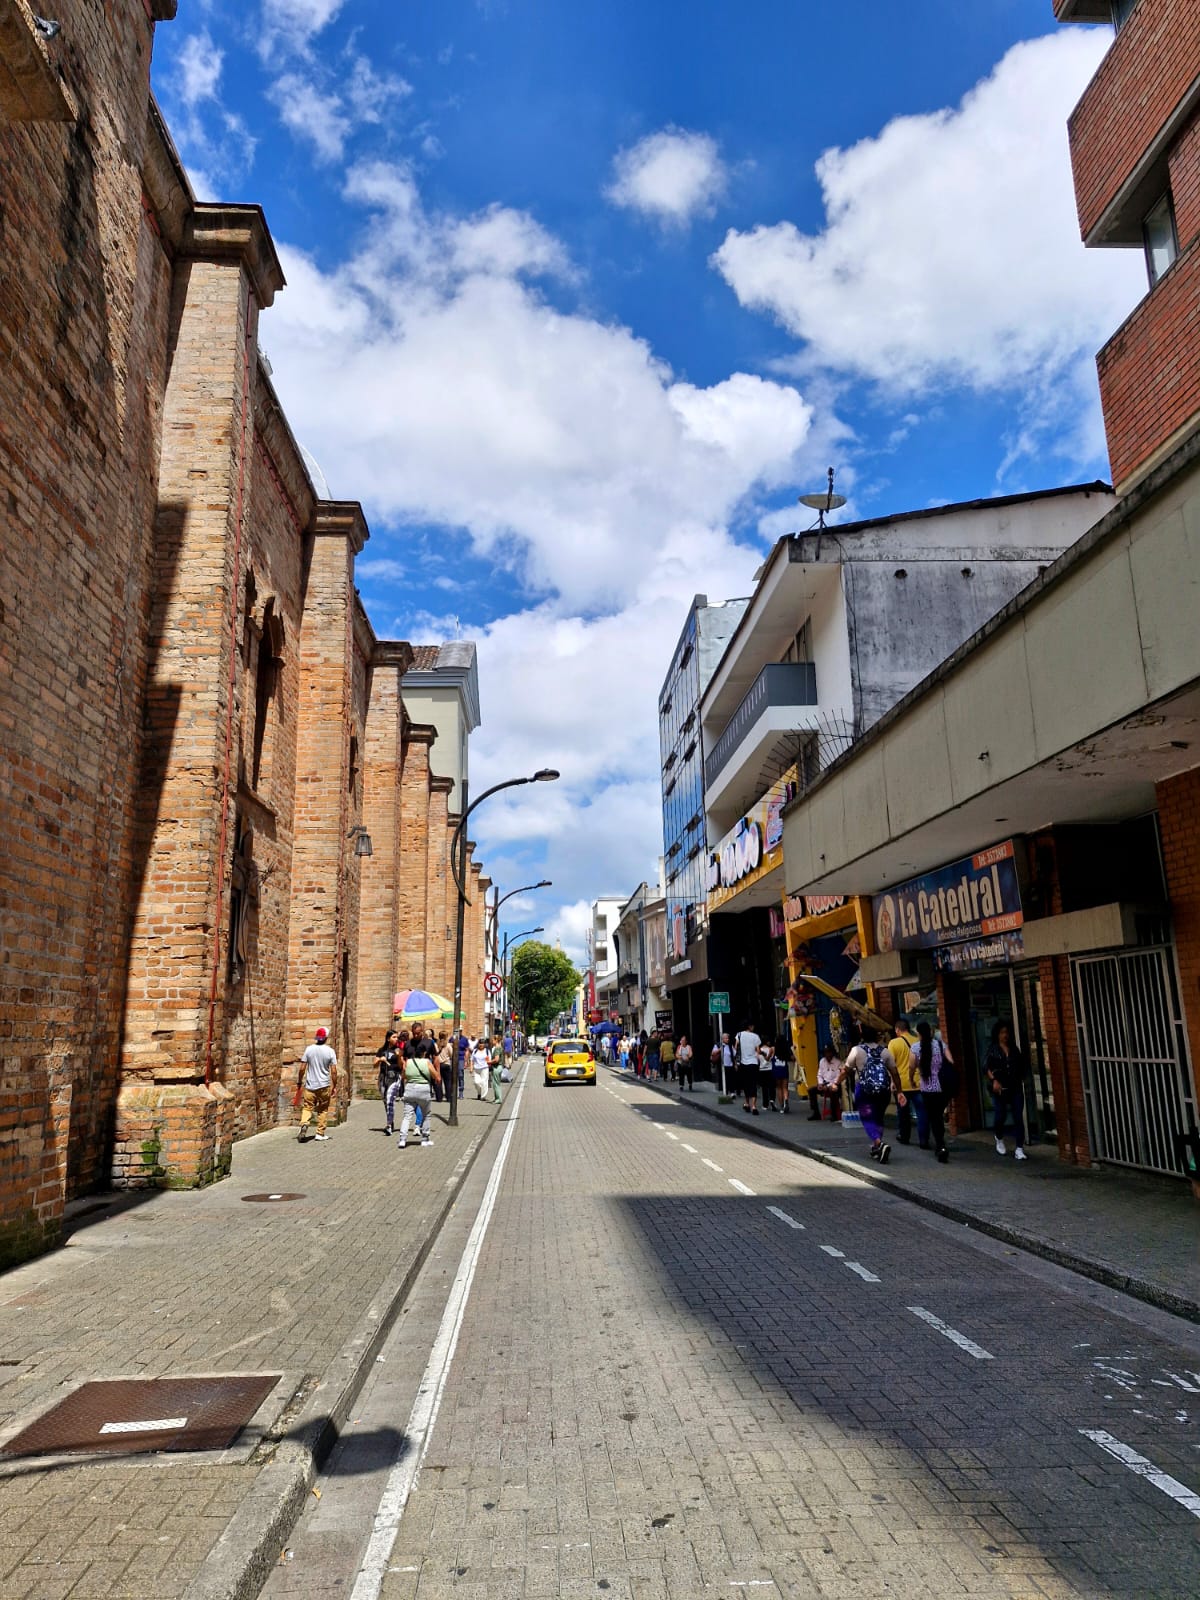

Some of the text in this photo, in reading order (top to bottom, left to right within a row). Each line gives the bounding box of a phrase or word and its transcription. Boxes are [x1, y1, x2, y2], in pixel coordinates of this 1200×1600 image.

[899, 864, 1003, 938] La Catedral
[970, 947, 978, 960] La
[978, 941, 1005, 958] Catedral
